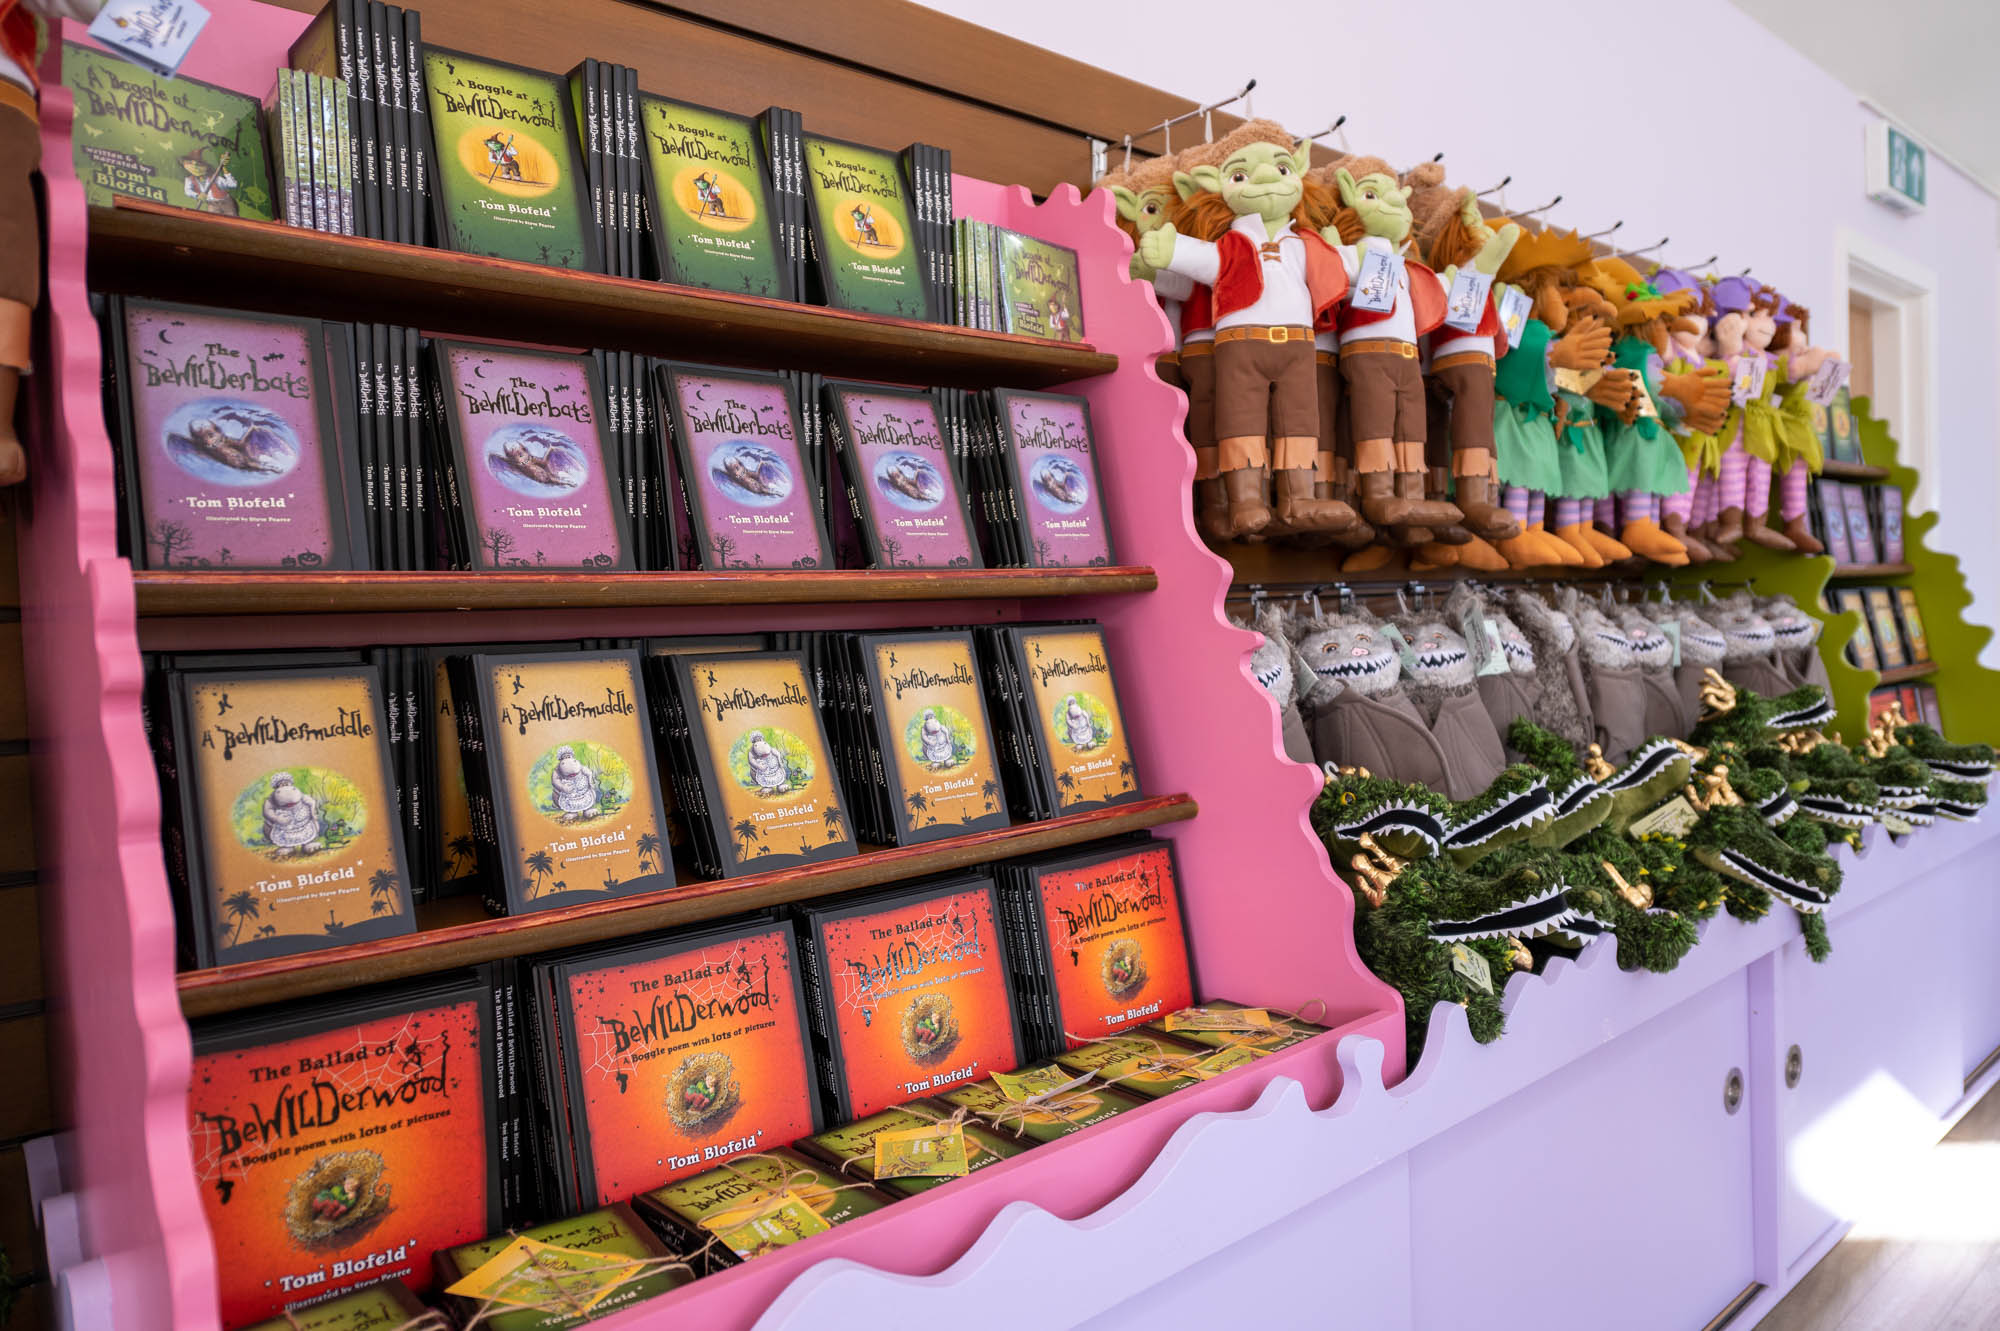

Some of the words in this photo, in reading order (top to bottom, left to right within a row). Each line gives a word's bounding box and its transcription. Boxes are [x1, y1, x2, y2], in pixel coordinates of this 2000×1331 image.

[87, 65, 104, 89] A
[99, 66, 168, 102] Boggle
[456, 79, 465, 87] A
[467, 80, 513, 96] Boggle
[516, 92, 528, 101] at
[668, 122, 675, 131] A
[677, 123, 715, 138] Boggle
[103, 163, 145, 184] Tom
[826, 159, 834, 167] A
[835, 160, 866, 172] Boggle
[95, 172, 165, 201] Blofeld
[479, 200, 505, 211] Tom
[508, 203, 551, 217] Blofeld
[691, 234, 713, 245] Tom
[715, 237, 751, 249] Blofeld
[851, 262, 870, 272] Tom
[871, 264, 902, 275] Blofeld
[204, 343, 240, 358] The
[509, 377, 537, 390] The
[724, 399, 747, 411] The
[883, 413, 903, 424] The
[1039, 417, 1057, 428] The
[186, 496, 222, 508] Tom
[226, 497, 287, 508] Blofeld
[506, 507, 534, 517] Tom
[537, 507, 582, 517] Blofeld
[728, 515, 752, 525] Tom
[753, 515, 790, 525] Blofeld
[894, 518, 914, 528] Tom
[915, 518, 945, 528] Blofeld
[1044, 520, 1061, 529] Tom
[1061, 520, 1087, 529] Blofeld
[1069, 763, 1086, 775] Tom
[1087, 757, 1113, 772] Blofeld
[922, 783, 944, 795] Tom
[944, 777, 975, 792] Blofeld
[752, 811, 776, 823] Tom
[777, 803, 815, 819] Blofeld
[549, 841, 579, 853] Tom
[580, 831, 626, 848] Blofeld
[256, 880, 293, 894] Tom
[296, 866, 356, 888] Blofeld
[1074, 880, 1094, 892] The
[1095, 871, 1125, 888] Ballad
[1127, 869, 1137, 880] of
[869, 927, 893, 941] The
[895, 917, 934, 936] Ballad
[936, 914, 949, 927] of
[1079, 932, 1100, 944] Boggle
[1100, 929, 1114, 938] poem
[1115, 926, 1127, 934] with
[1127, 923, 1140, 932] lots
[630, 978, 660, 994] The
[664, 966, 712, 987] Ballad
[716, 962, 732, 976] of
[496, 1005, 504, 1031] Ballad
[507, 1002, 515, 1028] Ballad
[1105, 1011, 1126, 1026] Tom
[1127, 1003, 1160, 1021] Blofeld
[631, 1047, 666, 1063] Boggle
[667, 1041, 690, 1055] poem
[691, 1036, 711, 1047] with
[711, 1030, 732, 1043] lots
[733, 1028, 742, 1037] of
[744, 1020, 776, 1033] pictures
[248, 1064, 292, 1084] The
[298, 1045, 368, 1074] Ballad
[375, 1040, 397, 1057] of
[903, 1078, 931, 1095] Tom
[932, 1065, 975, 1089] Blofeld
[229, 1160, 239, 1170] A
[241, 1146, 291, 1167] Boggle
[294, 1139, 328, 1156] poem
[331, 1132, 356, 1146] with
[359, 1123, 388, 1139] lots
[390, 1119, 403, 1131] of
[407, 1108, 452, 1127] pictures
[667, 1151, 700, 1171] Tom
[703, 1135, 757, 1162] Blofeld
[703, 1173, 743, 1193] Boggl
[279, 1270, 327, 1293] Tom
[331, 1245, 408, 1279] Blofeld
